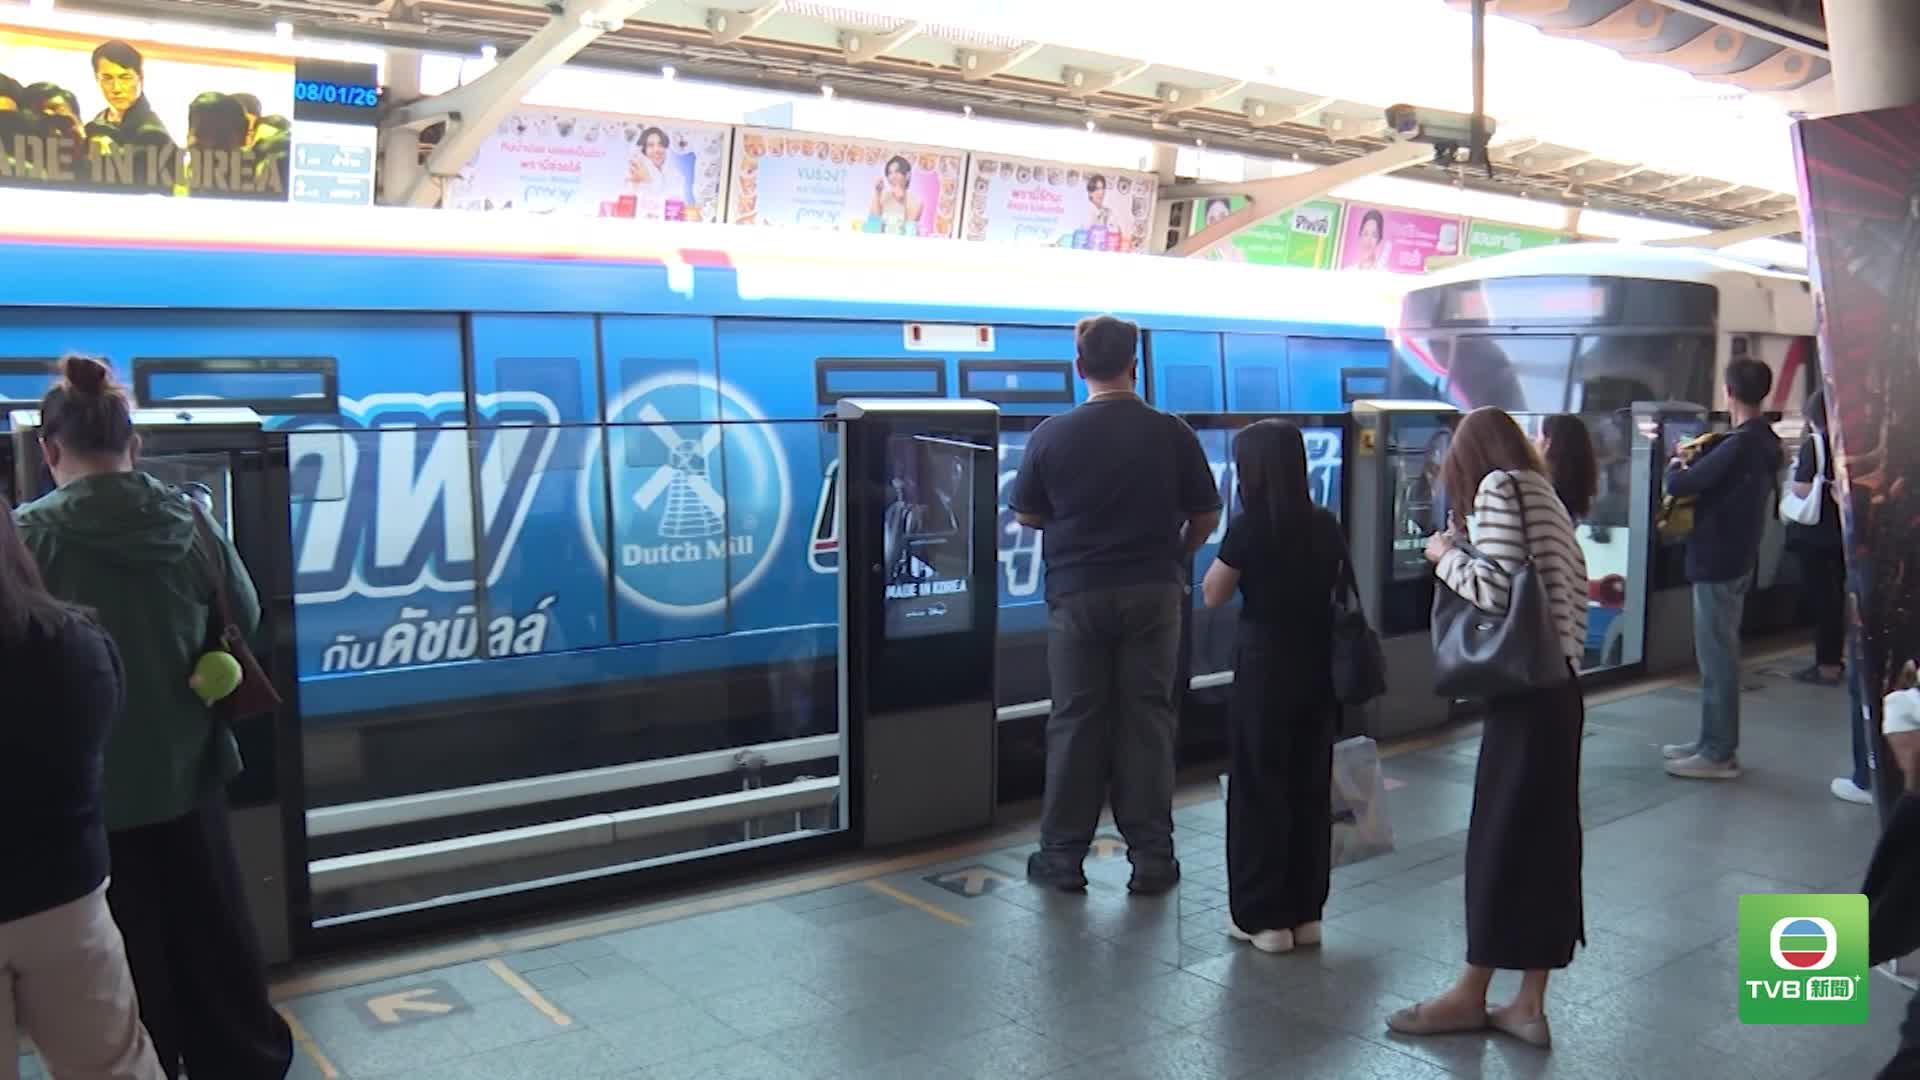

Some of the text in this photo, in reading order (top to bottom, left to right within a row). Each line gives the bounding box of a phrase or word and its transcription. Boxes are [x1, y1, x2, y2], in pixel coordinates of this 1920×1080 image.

[295, 82, 377, 106] 08/01/26
[91, 139, 133, 185] IN
[147, 145, 283, 193] KOREA
[623, 536, 753, 566] Dutch Mill
[885, 582, 918, 600] MADE
